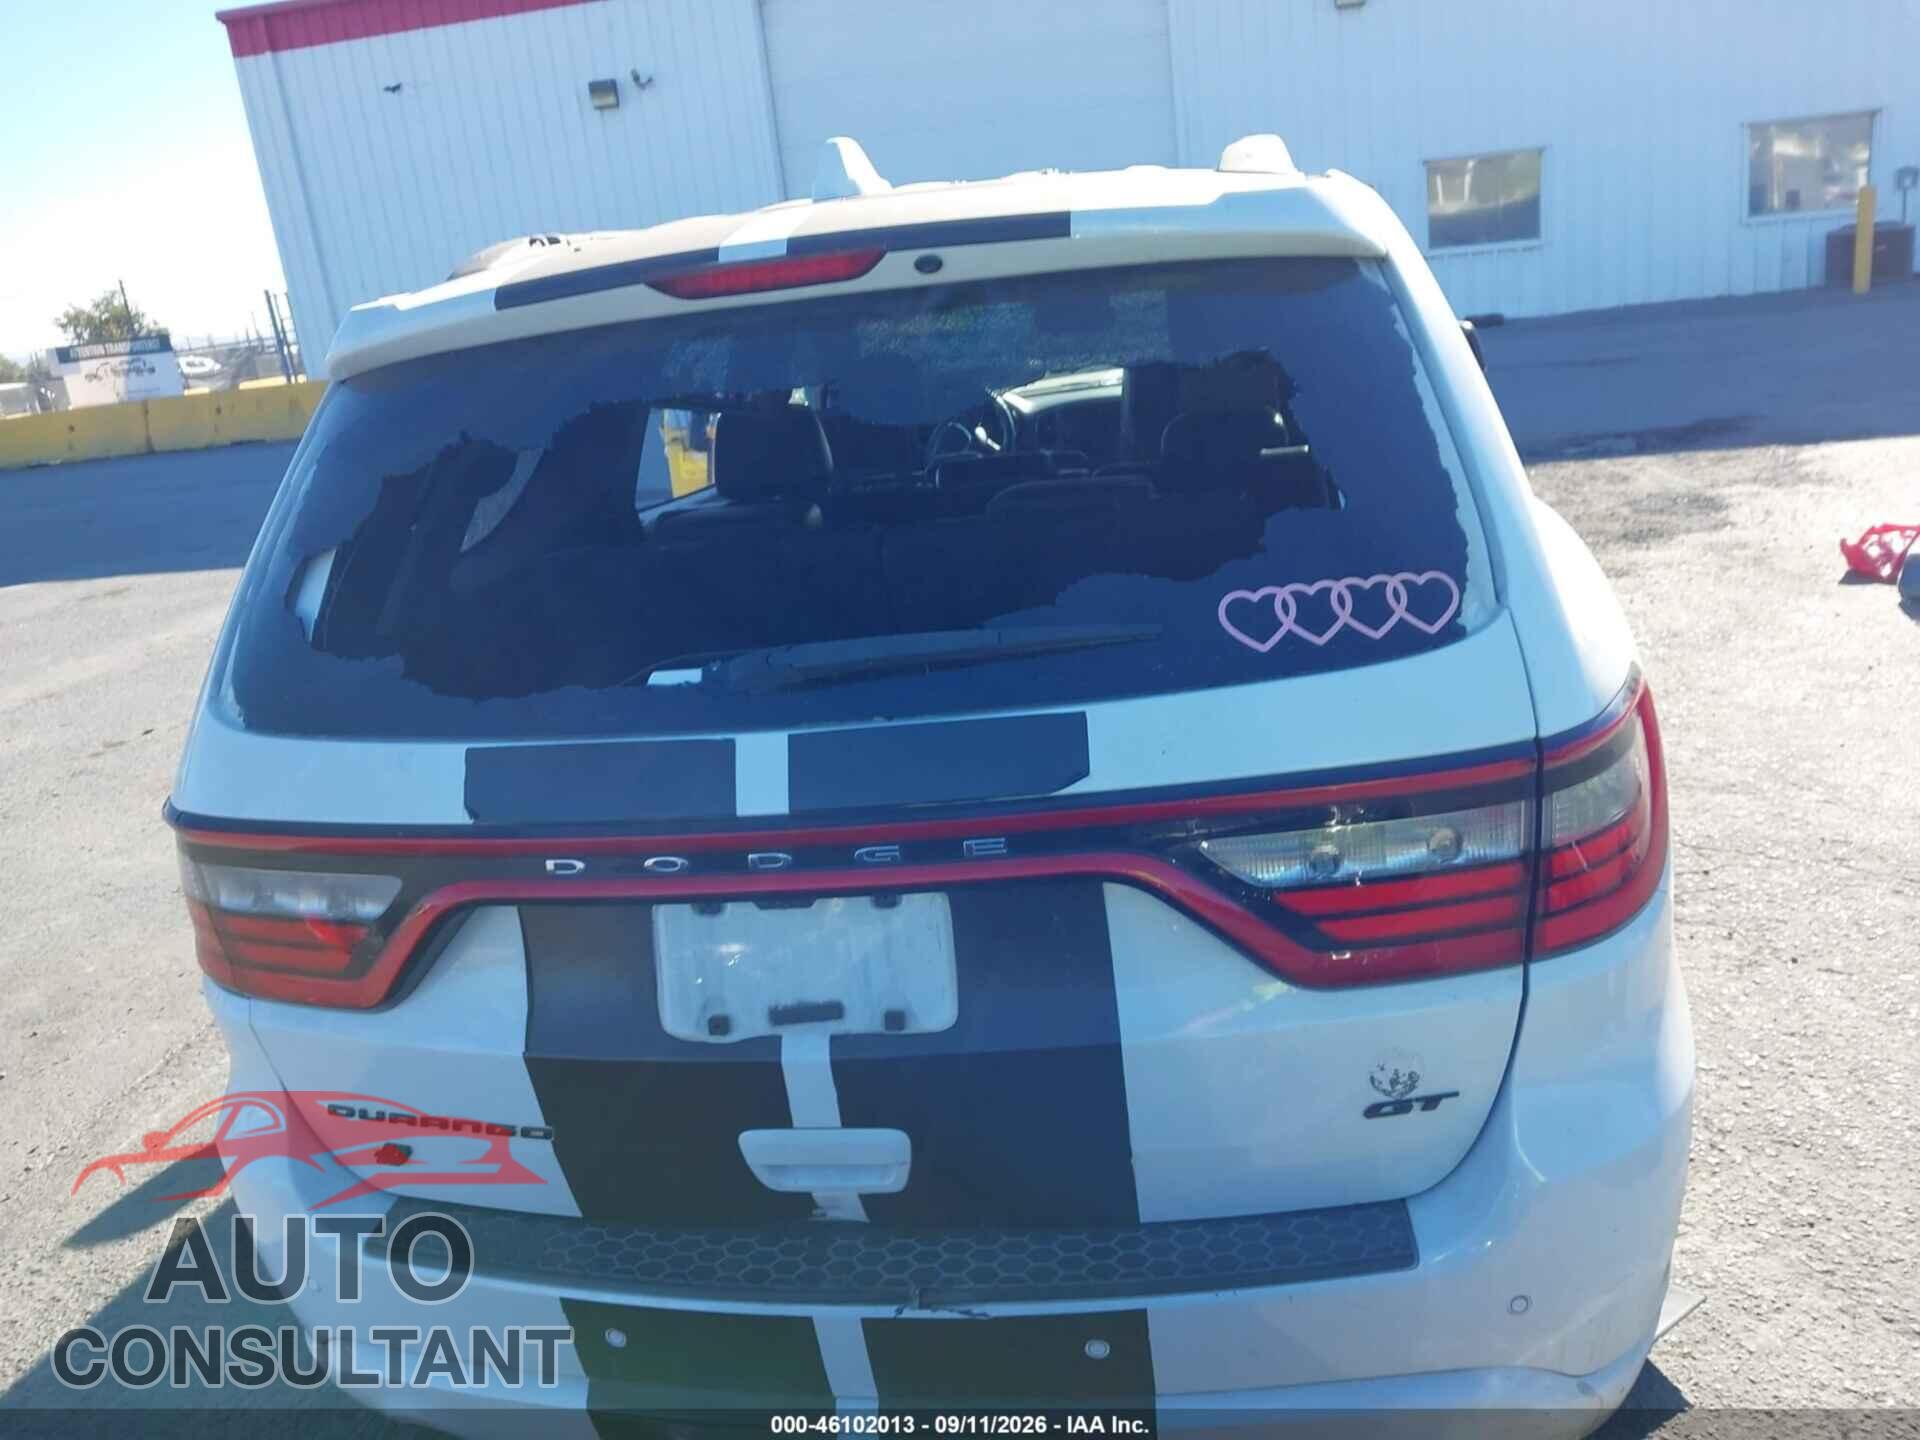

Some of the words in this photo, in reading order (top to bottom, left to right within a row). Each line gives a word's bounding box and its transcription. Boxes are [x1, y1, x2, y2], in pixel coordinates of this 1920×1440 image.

[545, 837, 1006, 875] DODGE
[327, 1103, 553, 1140] DURANGO
[1363, 1090, 1460, 1119] GT
